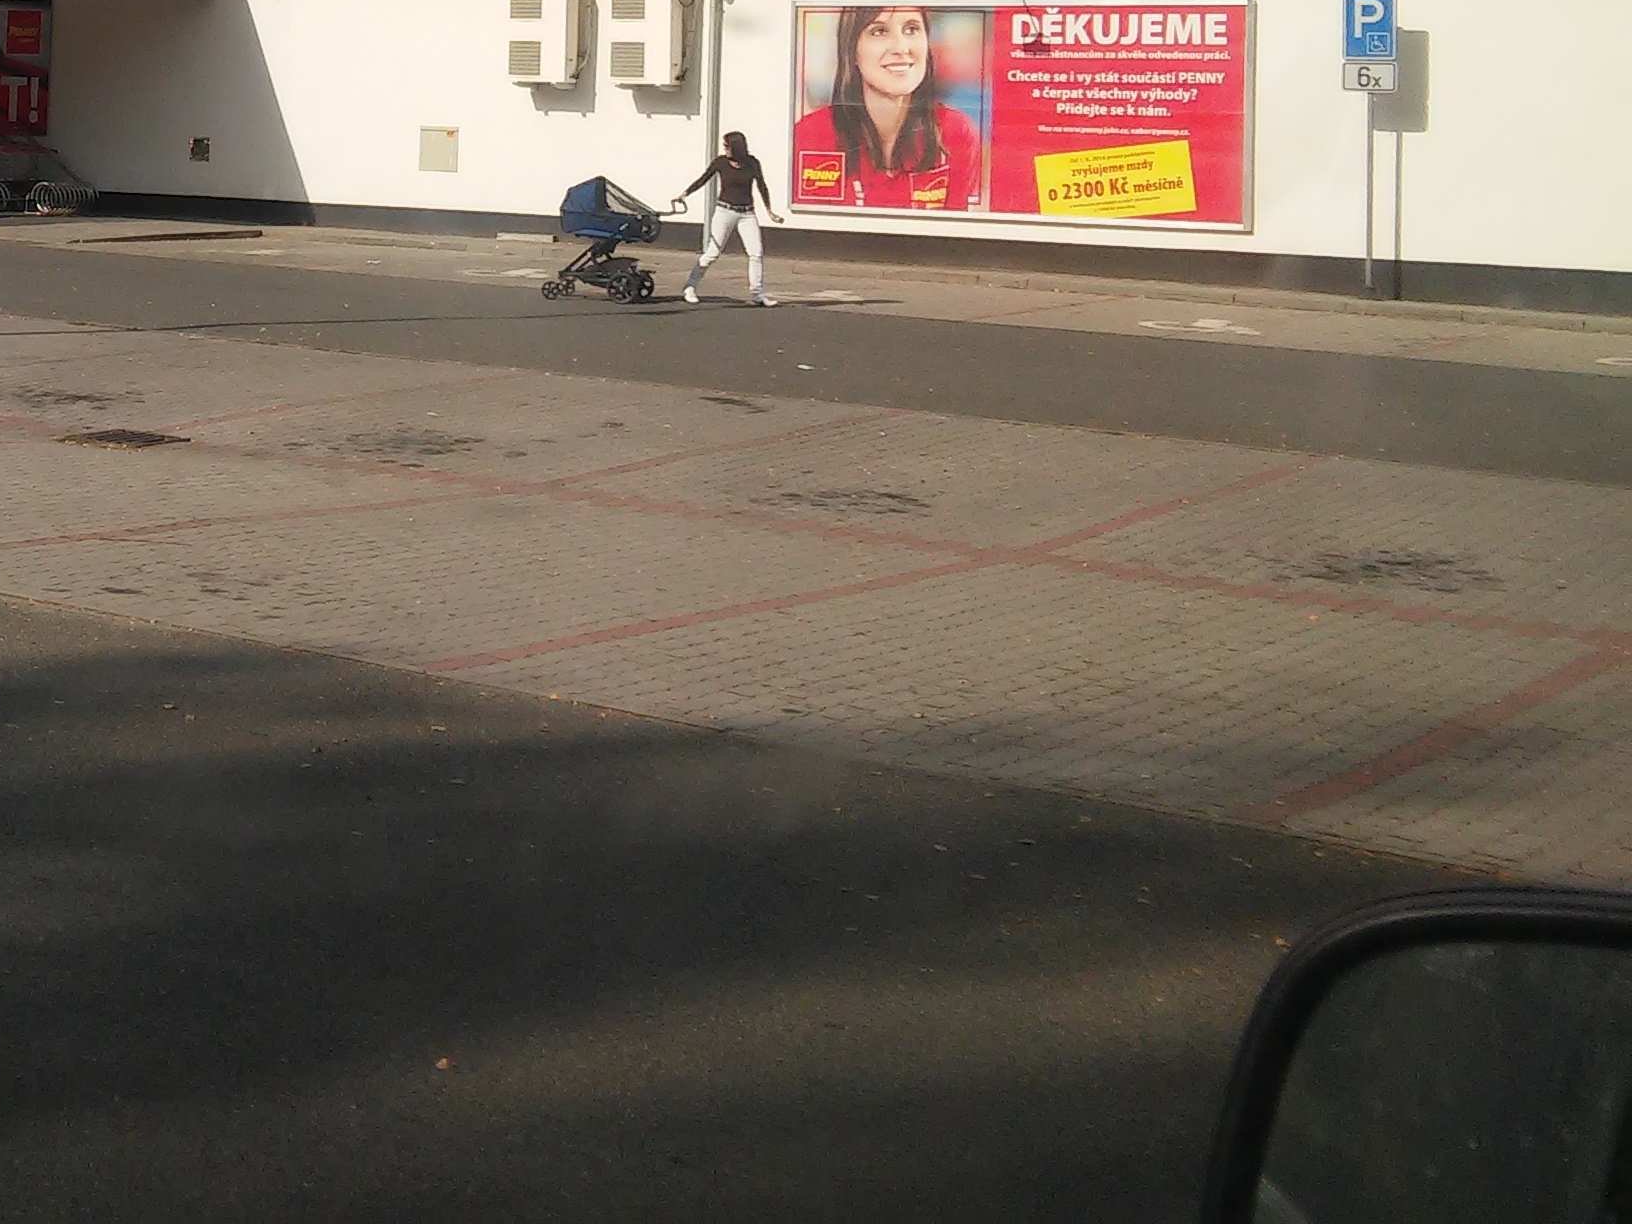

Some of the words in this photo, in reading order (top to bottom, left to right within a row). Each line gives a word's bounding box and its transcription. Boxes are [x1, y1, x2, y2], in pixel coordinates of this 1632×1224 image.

[1012, 7, 1227, 45] DĚKUJEME
[1008, 70, 1051, 82] Chcete
[1054, 73, 1068, 82] se
[1070, 71, 1074, 82] i
[1077, 73, 1092, 85] vy
[1095, 71, 1120, 83] stát
[1121, 71, 1176, 84] součástí
[1179, 72, 1225, 84] PENNY
[1357, 66, 1382, 88] 6x
[1032, 88, 1040, 98] a
[1043, 87, 1083, 101] čerpat
[1086, 87, 1138, 102] všechny
[1141, 88, 1198, 103] výhody?
[1057, 103, 1108, 117] Přidejte
[1110, 105, 1124, 115] se
[1127, 104, 1135, 115] k
[1138, 105, 1171, 117] nám.
[803, 169, 840, 181] PENNY
[1071, 163, 1125, 179] zvyšujeme
[1127, 158, 1154, 173] mzdy
[1049, 189, 1058, 201] o
[1062, 180, 1105, 201] 2300
[1109, 177, 1130, 196] Kč
[1133, 177, 1184, 194] měsíčně
